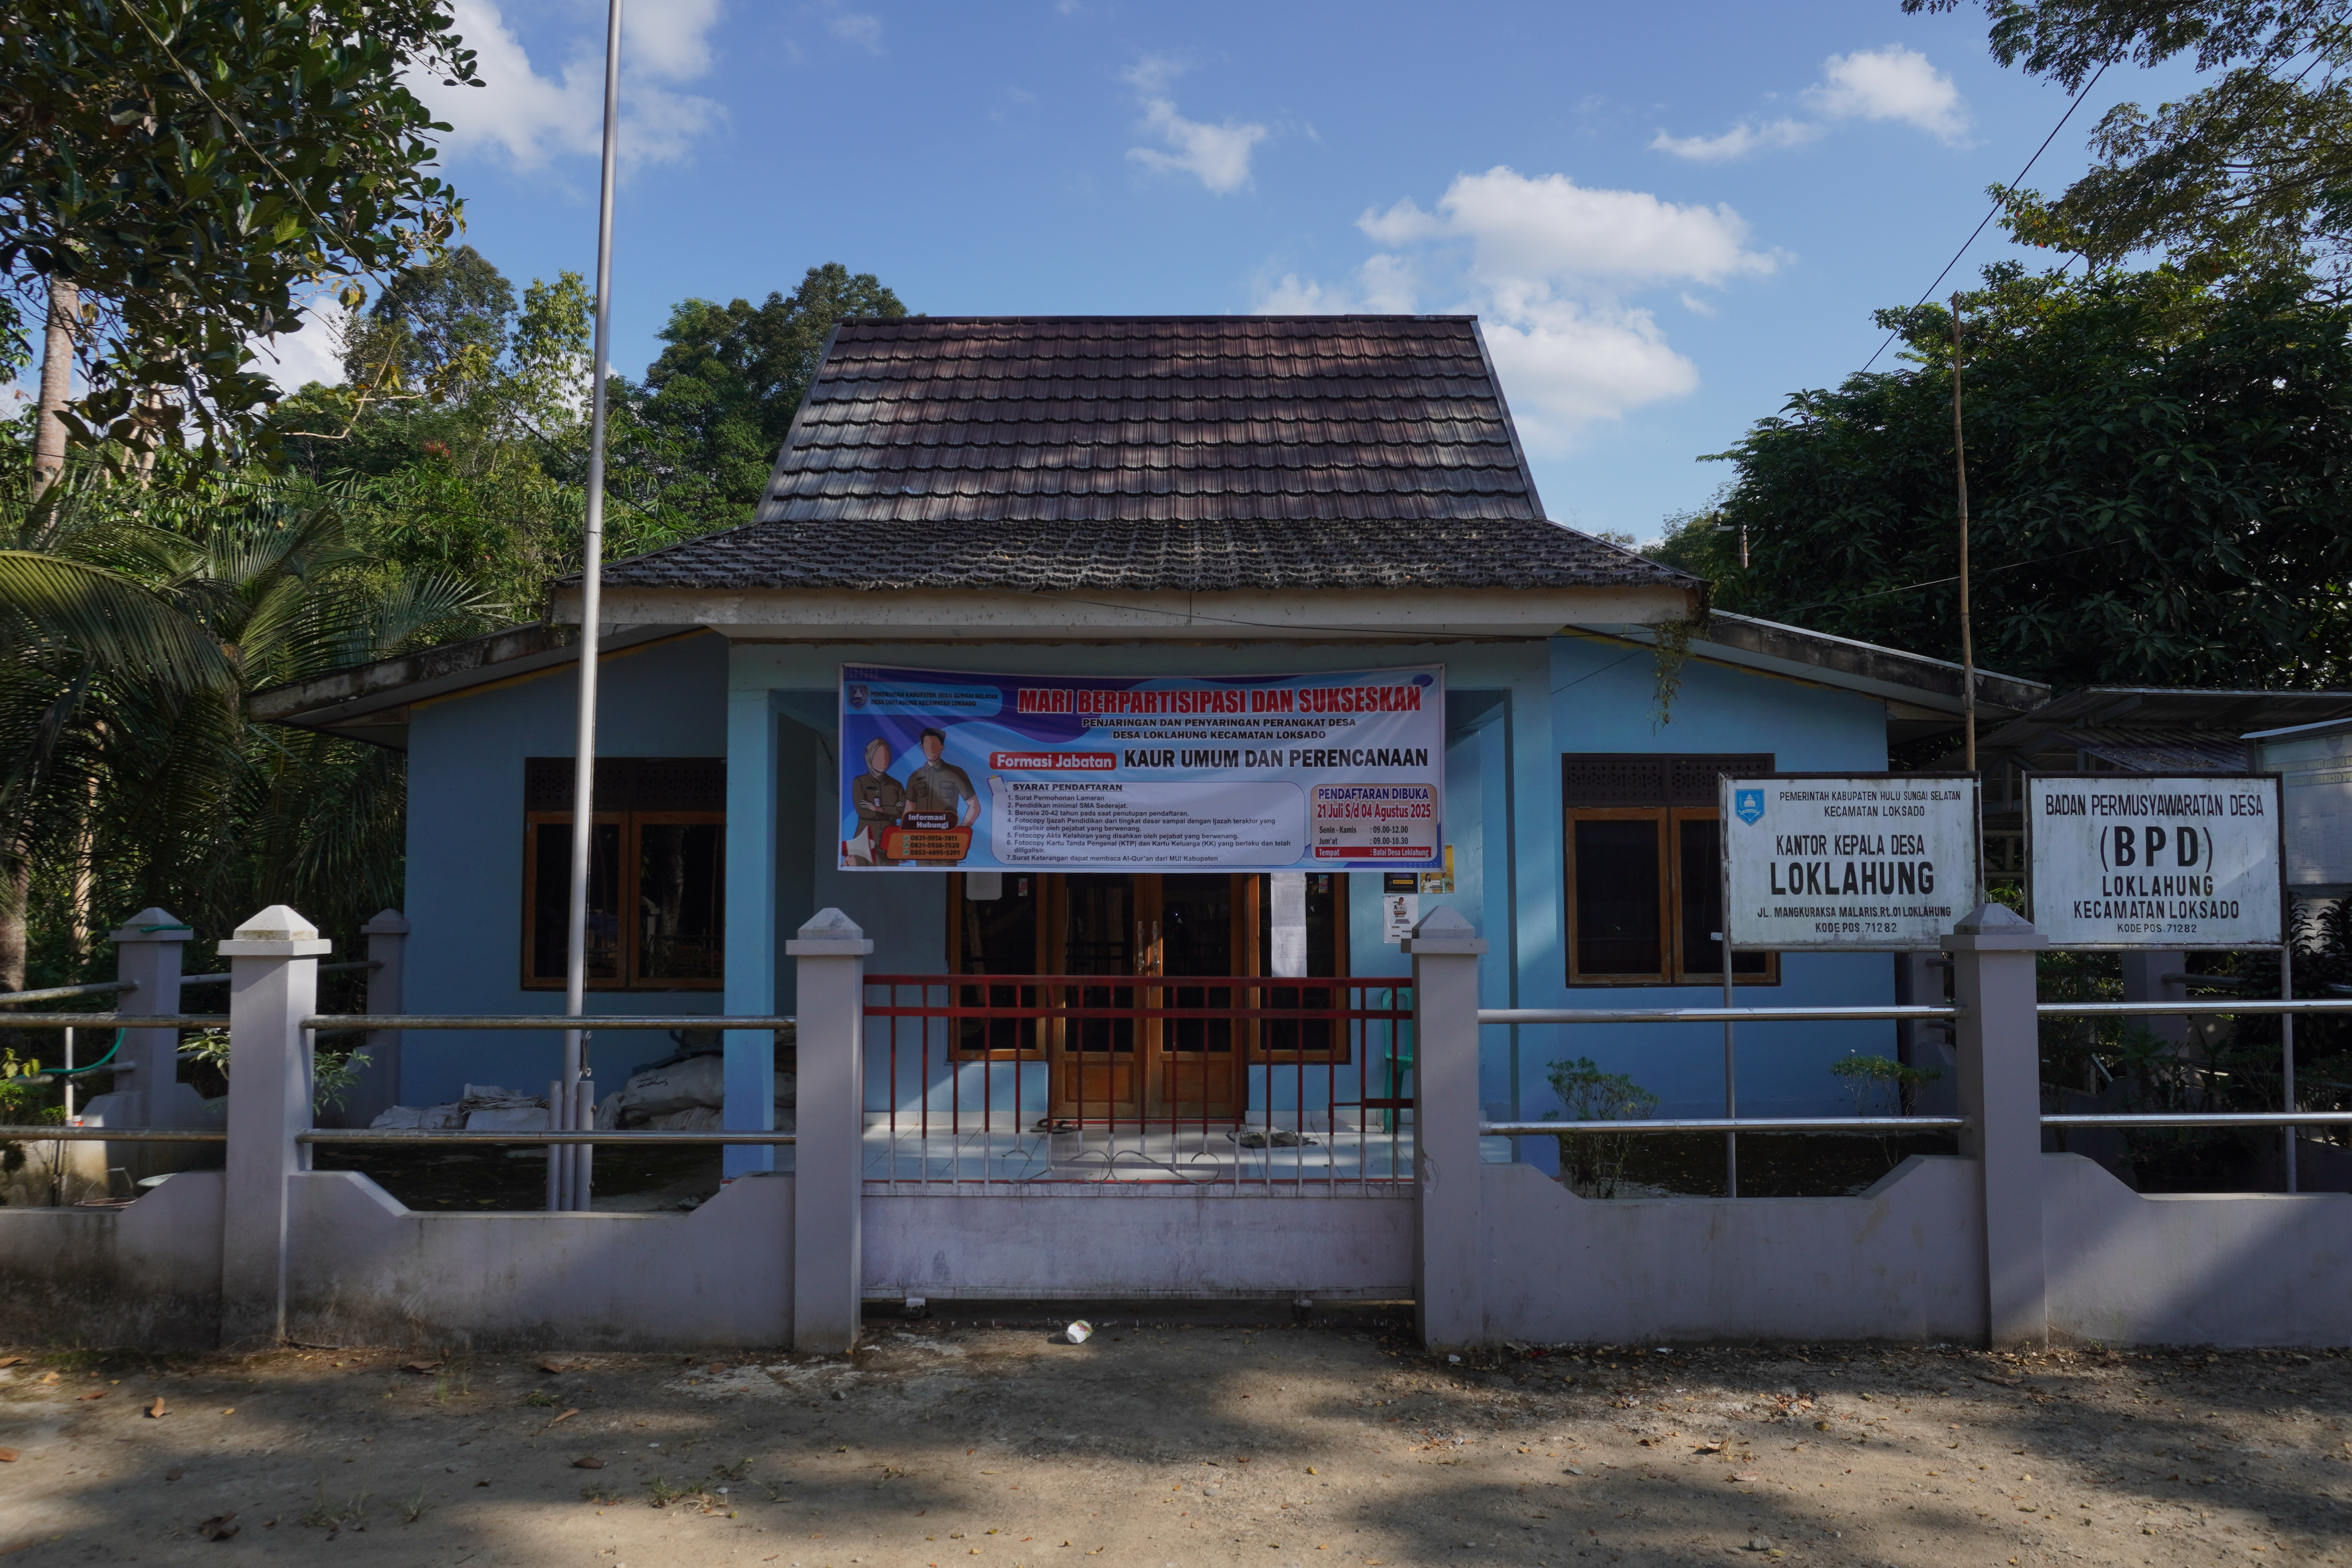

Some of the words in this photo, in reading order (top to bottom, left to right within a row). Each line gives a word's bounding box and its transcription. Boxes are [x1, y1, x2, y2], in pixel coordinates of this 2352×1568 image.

[1018, 689, 1073, 713] MARI
[1078, 690, 1246, 713] BERPARTISIPASI
[1252, 690, 1293, 713] DAN
[1298, 687, 1421, 713] SUKSESKAN
[1083, 719, 1156, 727] PENJARINGAN
[1160, 719, 1182, 727] DAN
[1185, 719, 1259, 727] PENYARINGAN
[1263, 719, 1326, 727] PERANGKAT
[1113, 731, 1140, 739] DESA
[1143, 731, 1207, 739] LOKLAHUNG
[1210, 731, 1273, 739] KECAMATAN
[1276, 731, 1326, 739] LOKSADO
[997, 754, 1052, 768] Formasi
[1055, 755, 1112, 768] Jabatan
[1124, 749, 1175, 768] KAUR
[1181, 749, 1239, 768] UMUM
[1245, 750, 1283, 768] DAN
[1289, 748, 1428, 768] PERENCANAAN
[1318, 788, 1389, 800] PENDAFTARAN
[1392, 788, 1429, 800] DIBUKA
[1780, 791, 1829, 801] PEMERINTAH
[1832, 791, 1877, 801] KABUPATEN
[1880, 791, 1900, 800] HULU
[1904, 791, 1927, 800] SUNGAI
[1931, 791, 1960, 800] SELATAN
[2045, 794, 2085, 816] BADAN
[2092, 794, 2223, 816] PERMUSYAWARATAN
[2230, 794, 2264, 816] DESA
[1317, 804, 1326, 818] 21
[1328, 803, 1343, 818] Juli
[1345, 802, 1359, 819] S/d
[1361, 804, 1372, 818] 04
[1375, 803, 1408, 822] Agustus
[1410, 803, 1431, 818] 2025
[1824, 806, 1878, 817] KECAMATAN
[1883, 806, 1924, 817] LOKSADO
[1777, 835, 1827, 855] KANTOR
[1835, 835, 1885, 855] KEPALA
[1891, 835, 1924, 855] DESA
[1319, 849, 1339, 857] Tempat
[1402, 849, 1428, 857] Loklahung
[1770, 862, 1934, 895] LOKLAHUNG
[2103, 876, 2213, 897] LOKLAHUNG
[1757, 907, 1772, 918] JL.
[1774, 907, 1836, 917] MANGKURAKSA
[1903, 907, 1951, 917] LOKLAHUNG
[2074, 901, 2165, 919] KECAMATAN
[2170, 901, 2239, 919] LOKSADO
[1815, 923, 1840, 933] KODE
[2118, 924, 2142, 933] KODE
